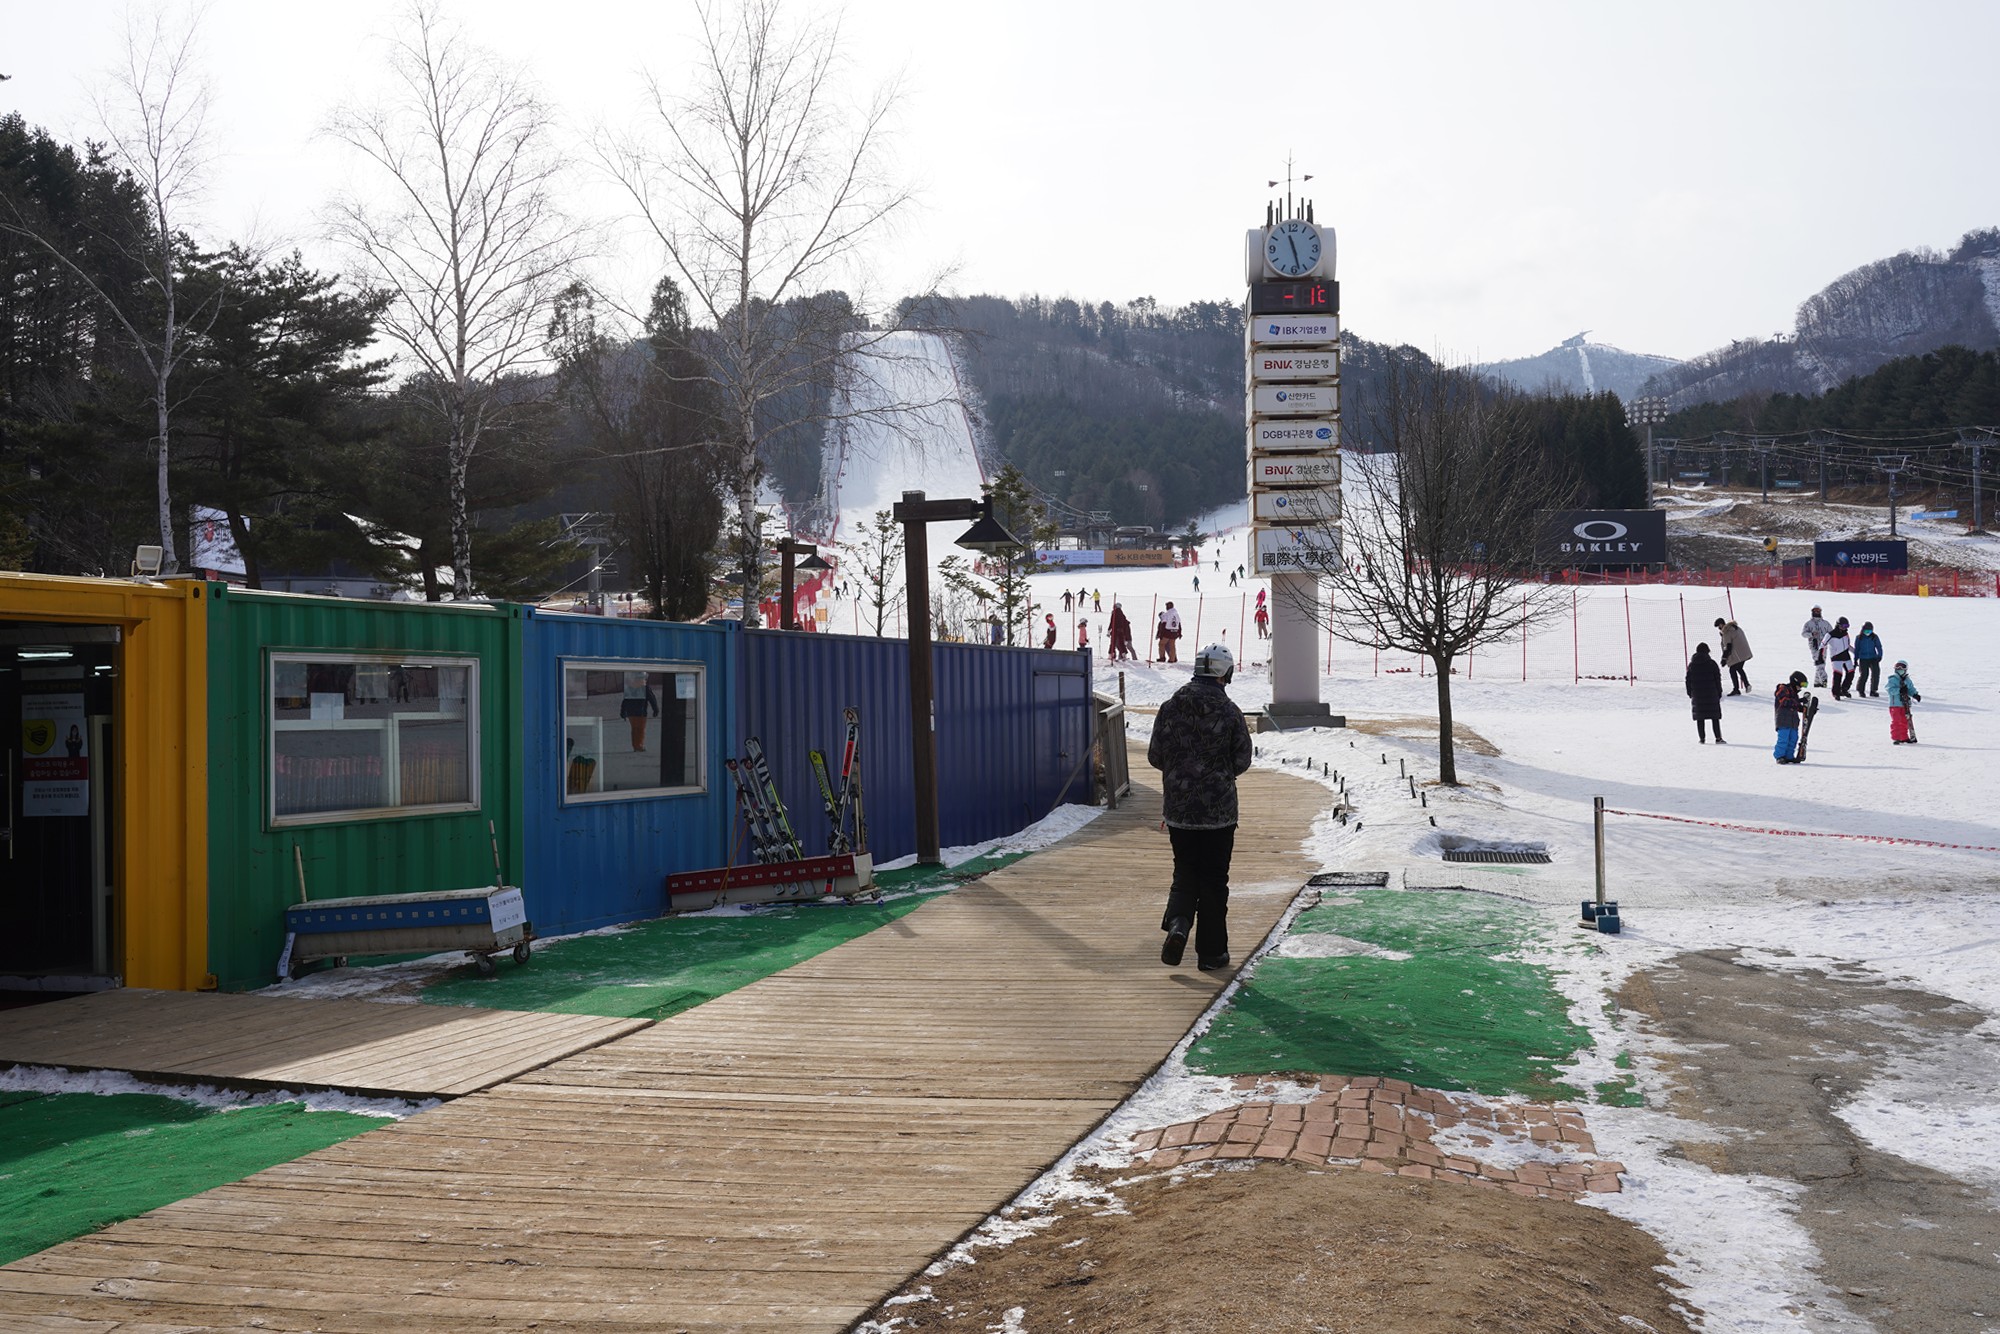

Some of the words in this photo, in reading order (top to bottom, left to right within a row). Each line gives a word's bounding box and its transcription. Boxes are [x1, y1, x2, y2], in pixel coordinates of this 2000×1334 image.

[1288, 223, 1299, 233] 12
[1269, 244, 1277, 254] 9
[1311, 244, 1319, 254] 3
[1290, 265, 1298, 275] 6
[1264, 360, 1293, 370] BNK
[1295, 359, 1330, 370] 경남은행
[1287, 392, 1317, 401] 신한카드
[1265, 465, 1294, 475] BNK
[1560, 542, 1640, 552] OAKLEY
[1851, 553, 1889, 564] 신한카드
